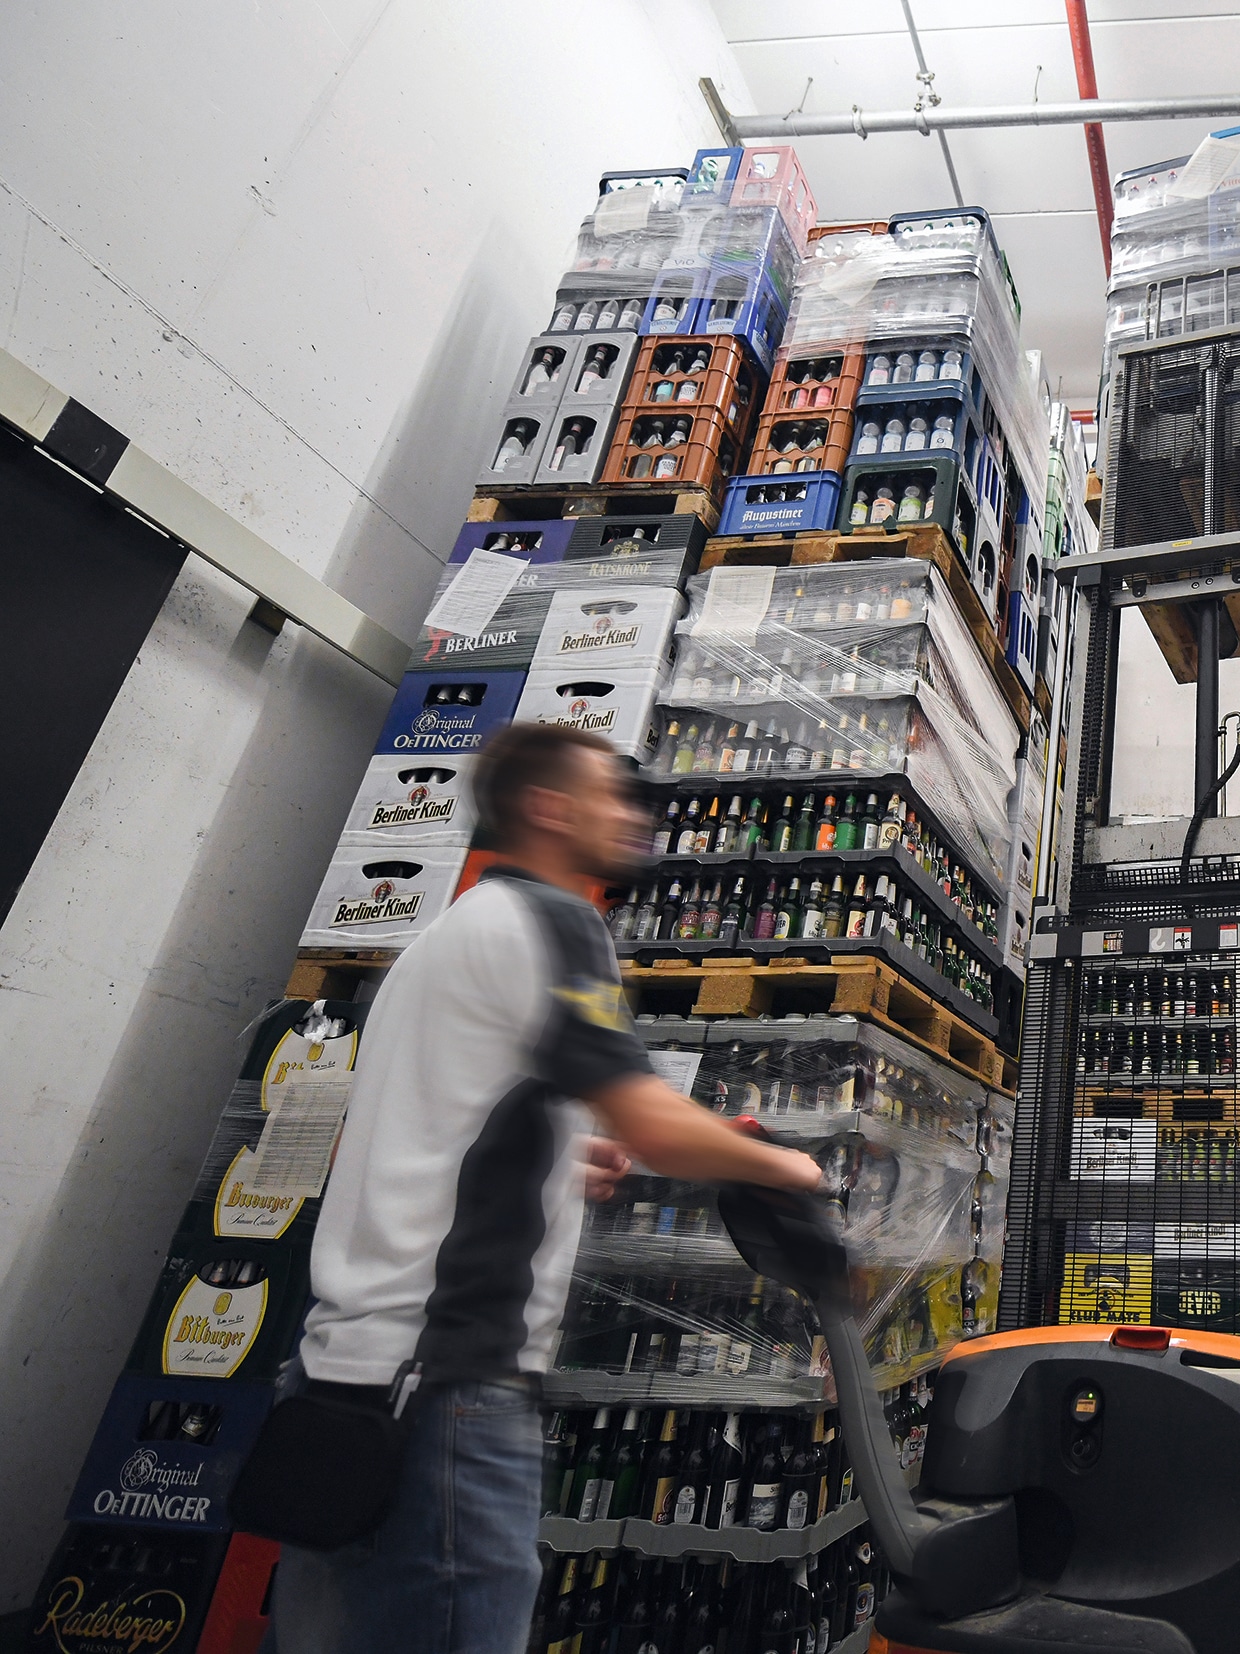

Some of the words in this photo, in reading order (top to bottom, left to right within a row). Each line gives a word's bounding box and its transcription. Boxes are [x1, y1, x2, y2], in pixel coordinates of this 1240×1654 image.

[742, 509, 803, 523] Augustiner
[588, 561, 651, 576] RATSKRONE
[445, 630, 517, 653] BERLINER
[561, 631, 606, 650] Berliner
[607, 626, 638, 643] Kindl
[411, 709, 476, 735] Original
[583, 710, 614, 730] Kindl
[372, 804, 420, 825] Berliner
[421, 799, 454, 818] Kindl
[335, 902, 384, 924] Berliner
[384, 896, 419, 917] Kindl
[1178, 1291, 1221, 1315] JEVER
[174, 1316, 245, 1349] Bitburger
[120, 1447, 205, 1493] Original
[34, 1576, 175, 1652] Radeberger
